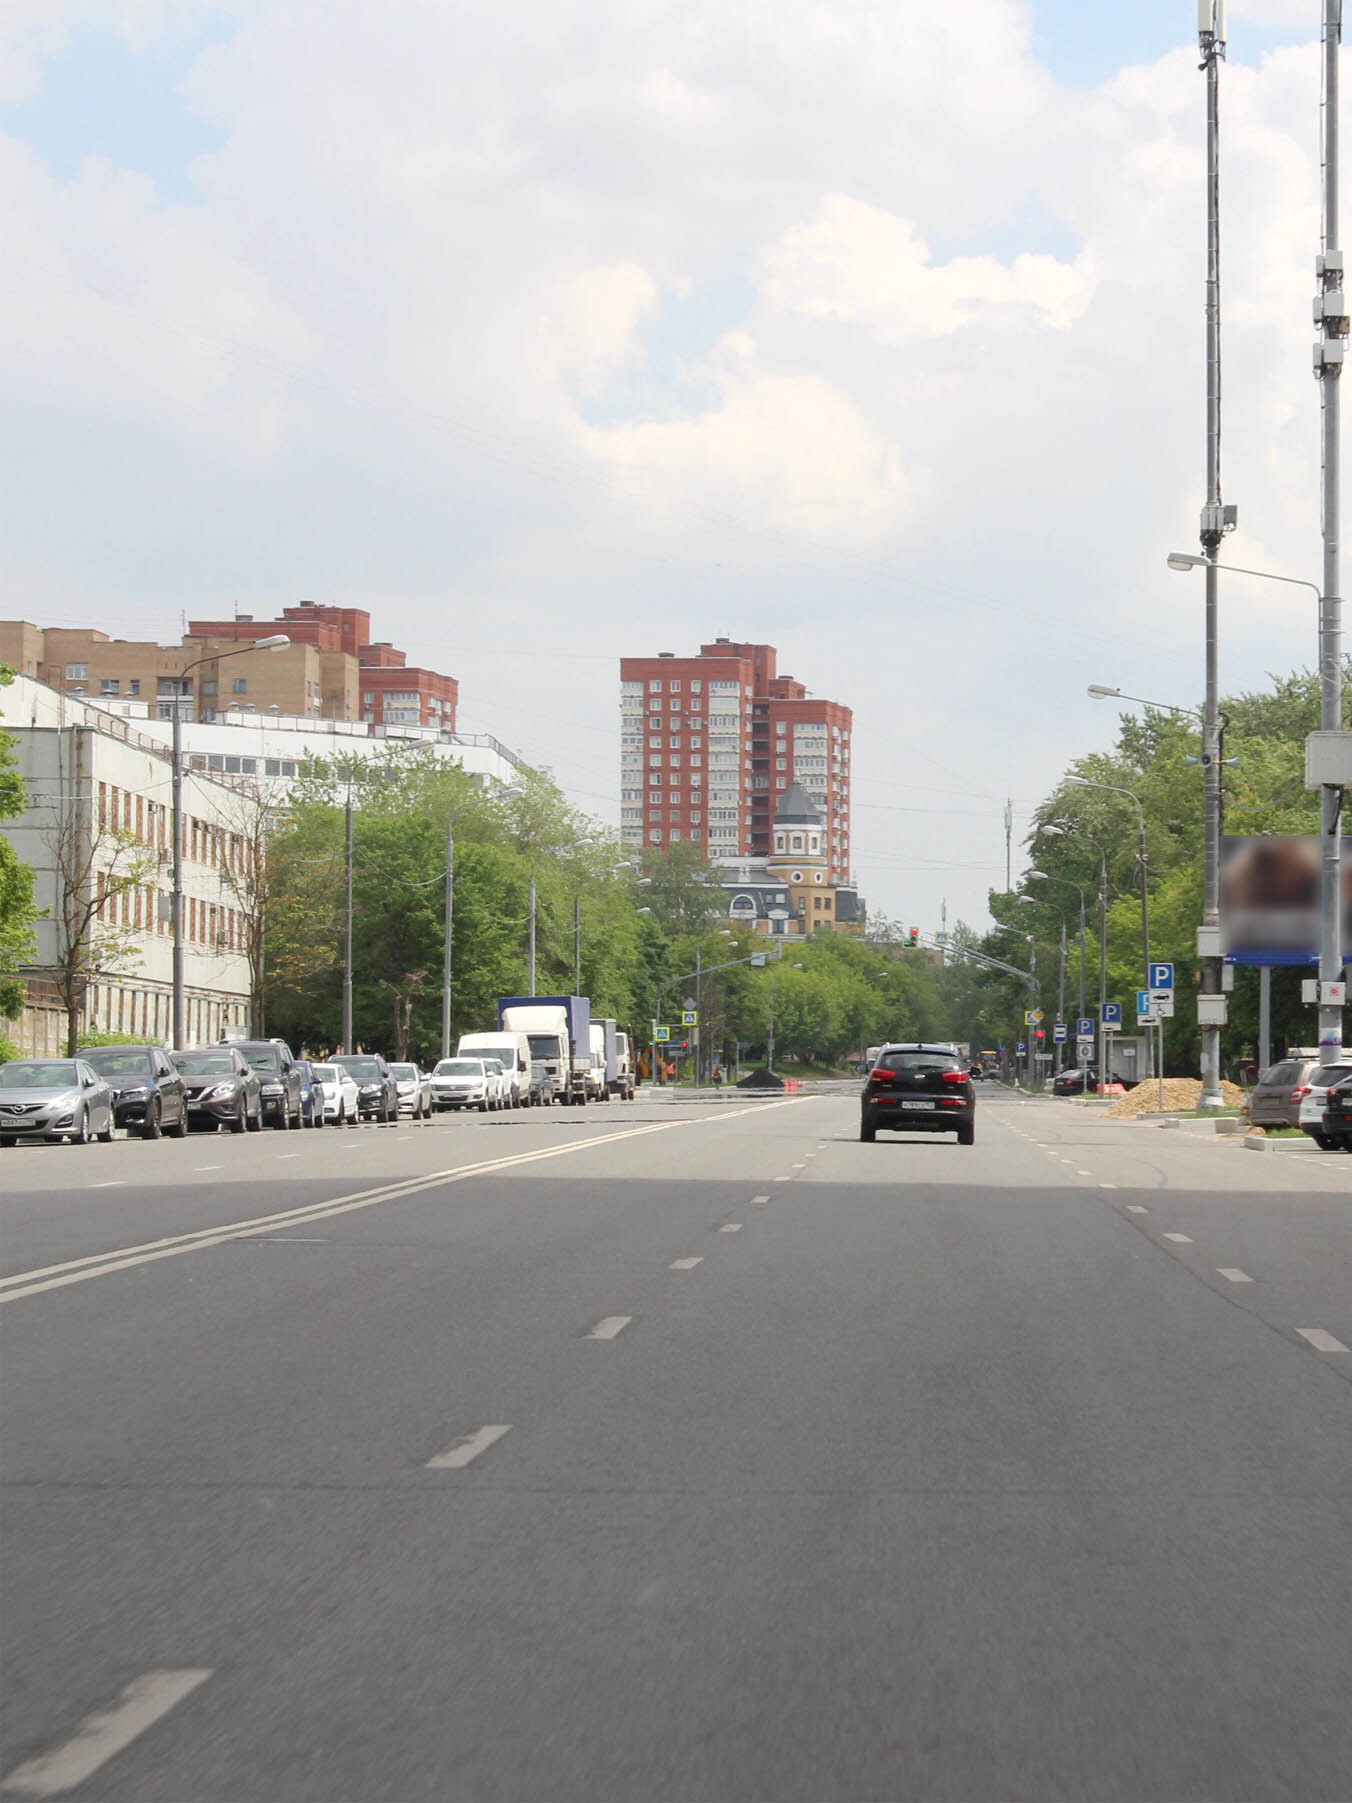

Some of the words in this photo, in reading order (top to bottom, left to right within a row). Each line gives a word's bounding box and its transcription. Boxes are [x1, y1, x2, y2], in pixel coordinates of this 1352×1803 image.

[1155, 966, 1169, 987] P
[1105, 1005, 1117, 1020] P
[1080, 1021, 1090, 1033] P
